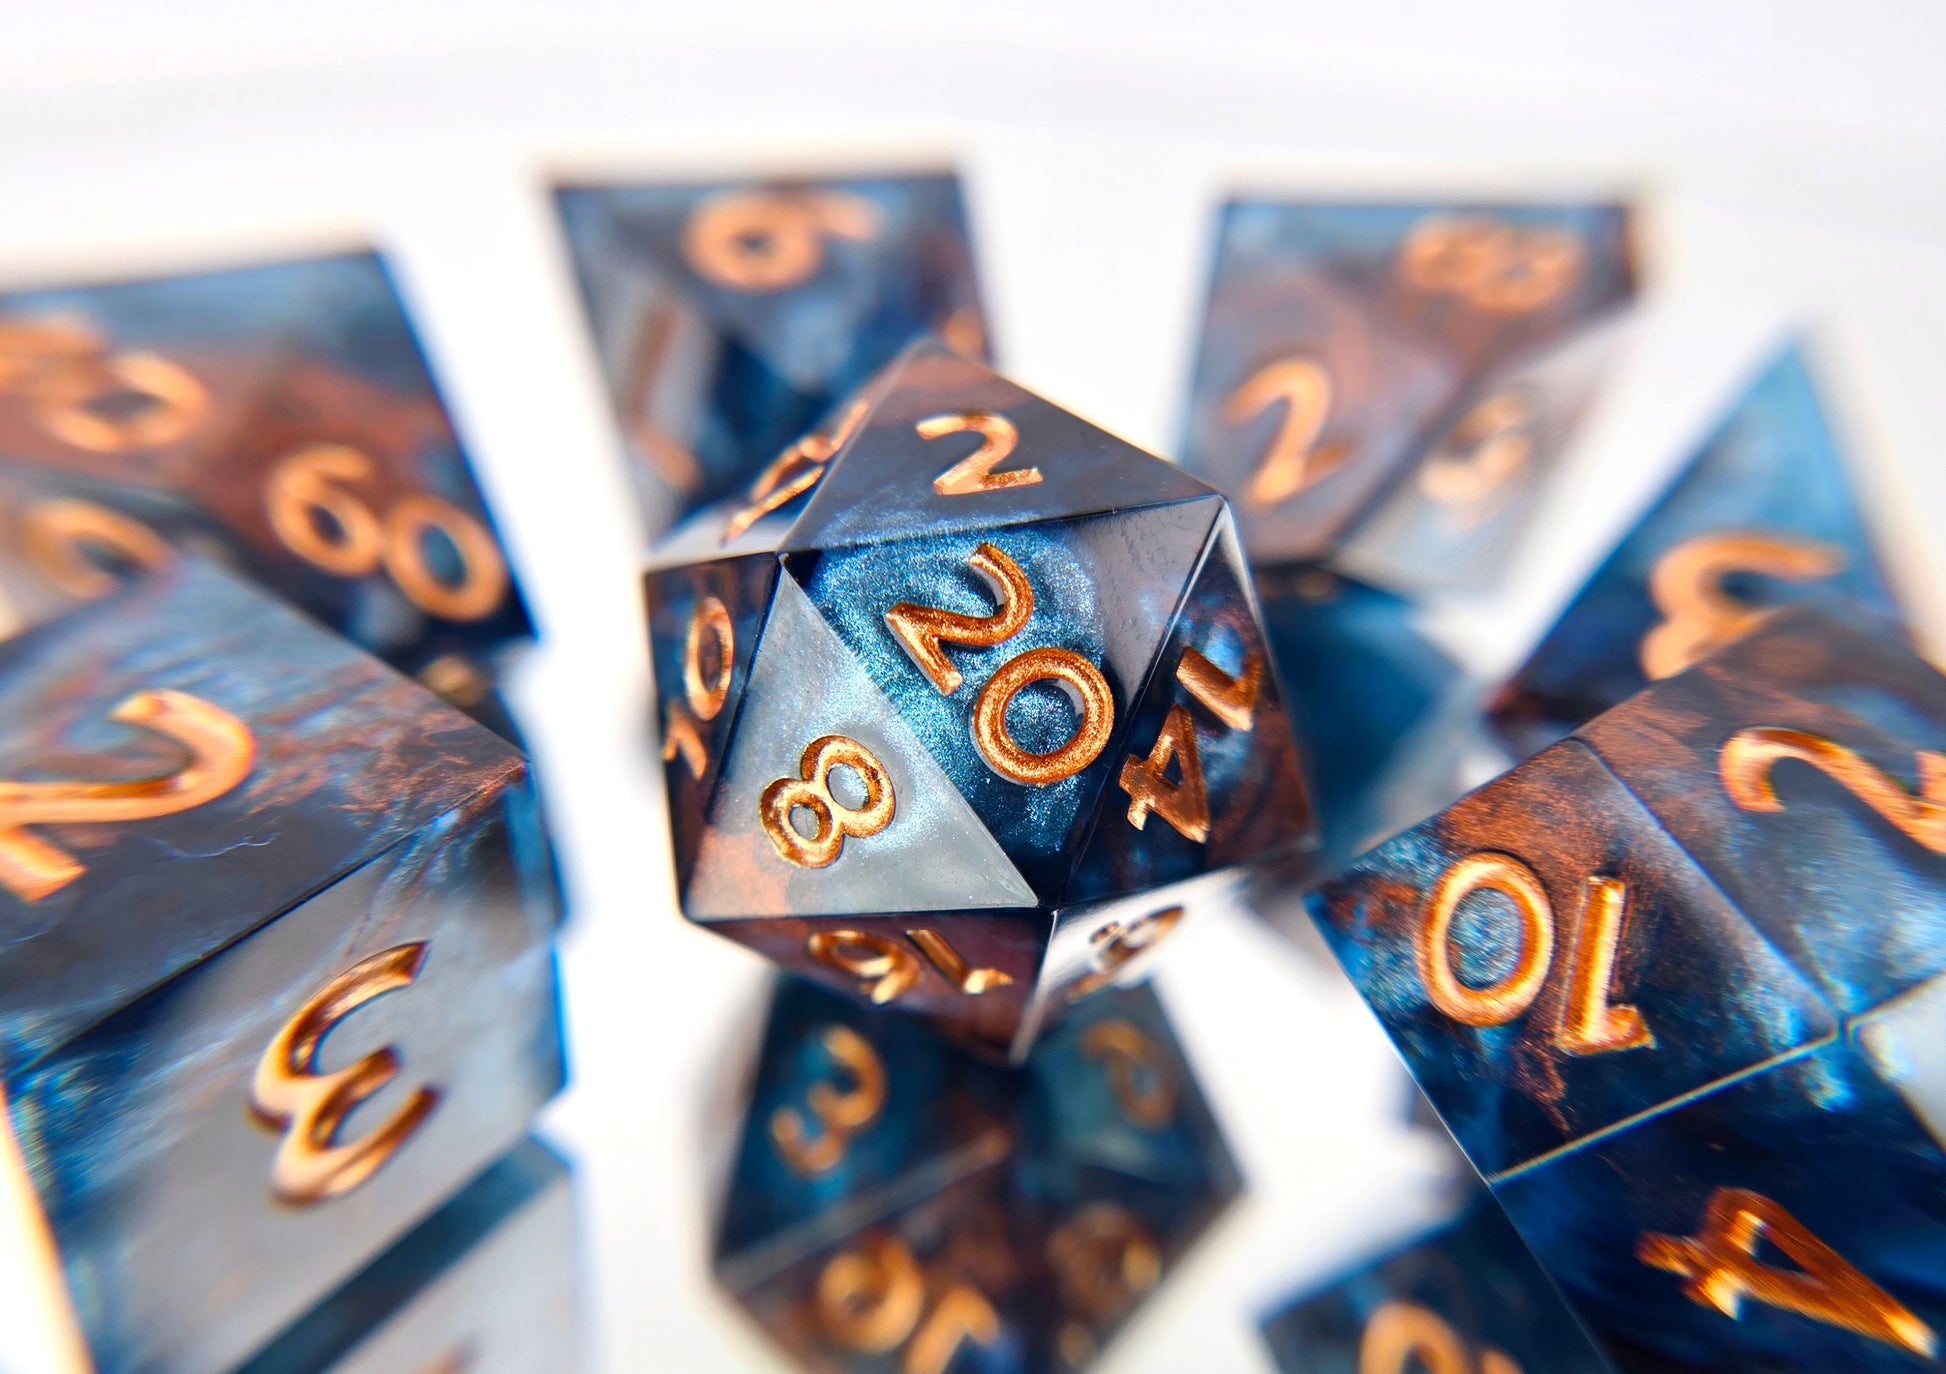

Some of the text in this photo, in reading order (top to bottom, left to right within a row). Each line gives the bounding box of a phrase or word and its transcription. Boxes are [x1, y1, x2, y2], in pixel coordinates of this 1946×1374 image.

[915, 412, 1044, 497] 2
[1221, 358, 1355, 505] 2
[267, 442, 510, 623] 60
[661, 596, 735, 781] 10
[884, 541, 1115, 786] 20
[1118, 645, 1263, 845] 14
[0, 687, 257, 903] 2
[758, 734, 897, 869] 8
[1718, 726, 1946, 856] 2
[1415, 850, 1658, 1057] 10
[250, 938, 447, 1207] 3
[1634, 1185, 1940, 1361] 4
